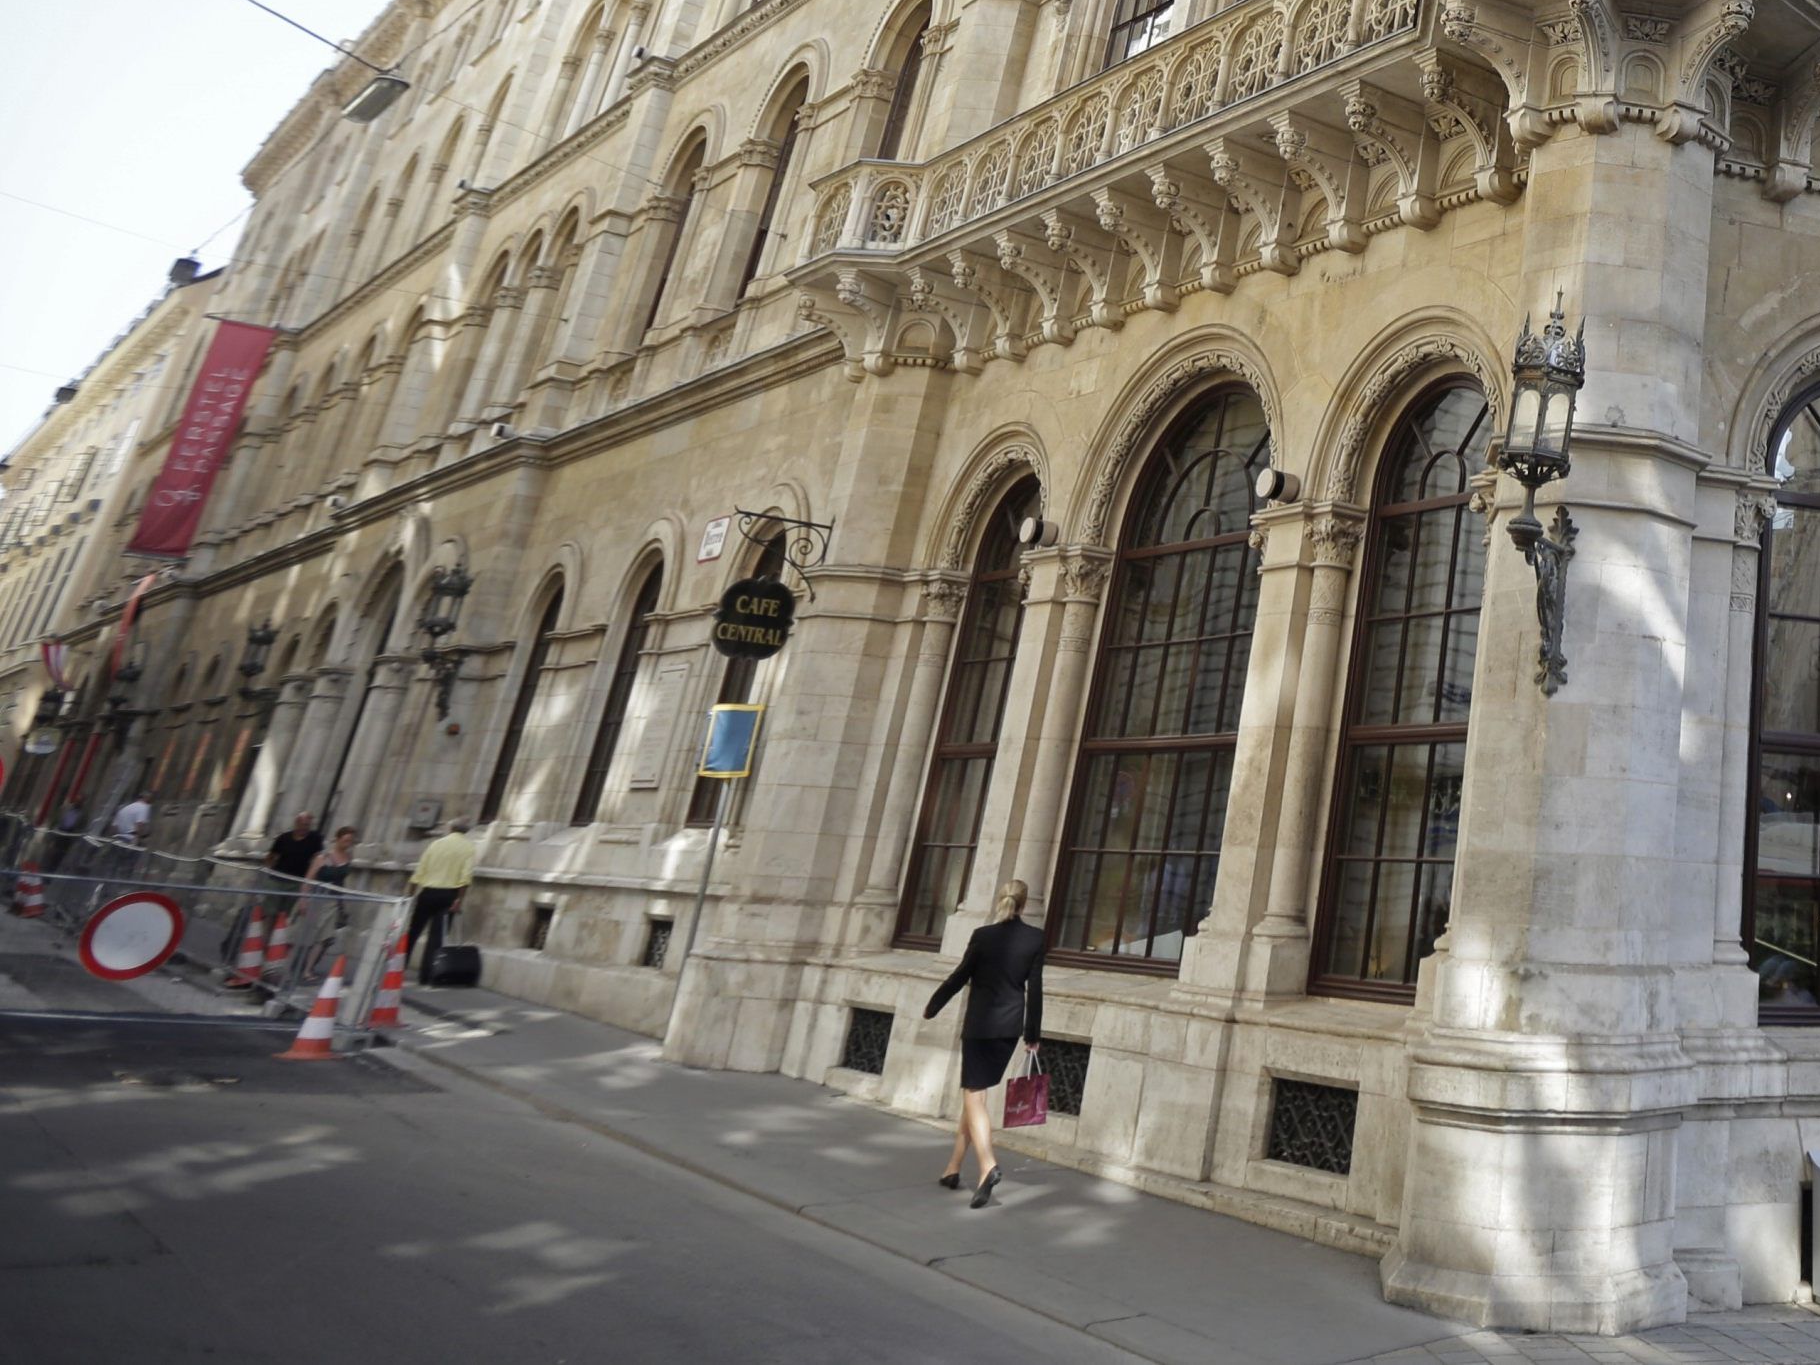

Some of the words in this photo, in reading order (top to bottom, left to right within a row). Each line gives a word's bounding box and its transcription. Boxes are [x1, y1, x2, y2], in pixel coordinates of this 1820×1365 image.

[173, 368, 228, 471] FERSTEL
[192, 367, 250, 474] PASSAGE
[716, 623, 781, 646] CENTRAL
[735, 596, 780, 617] CAFE
